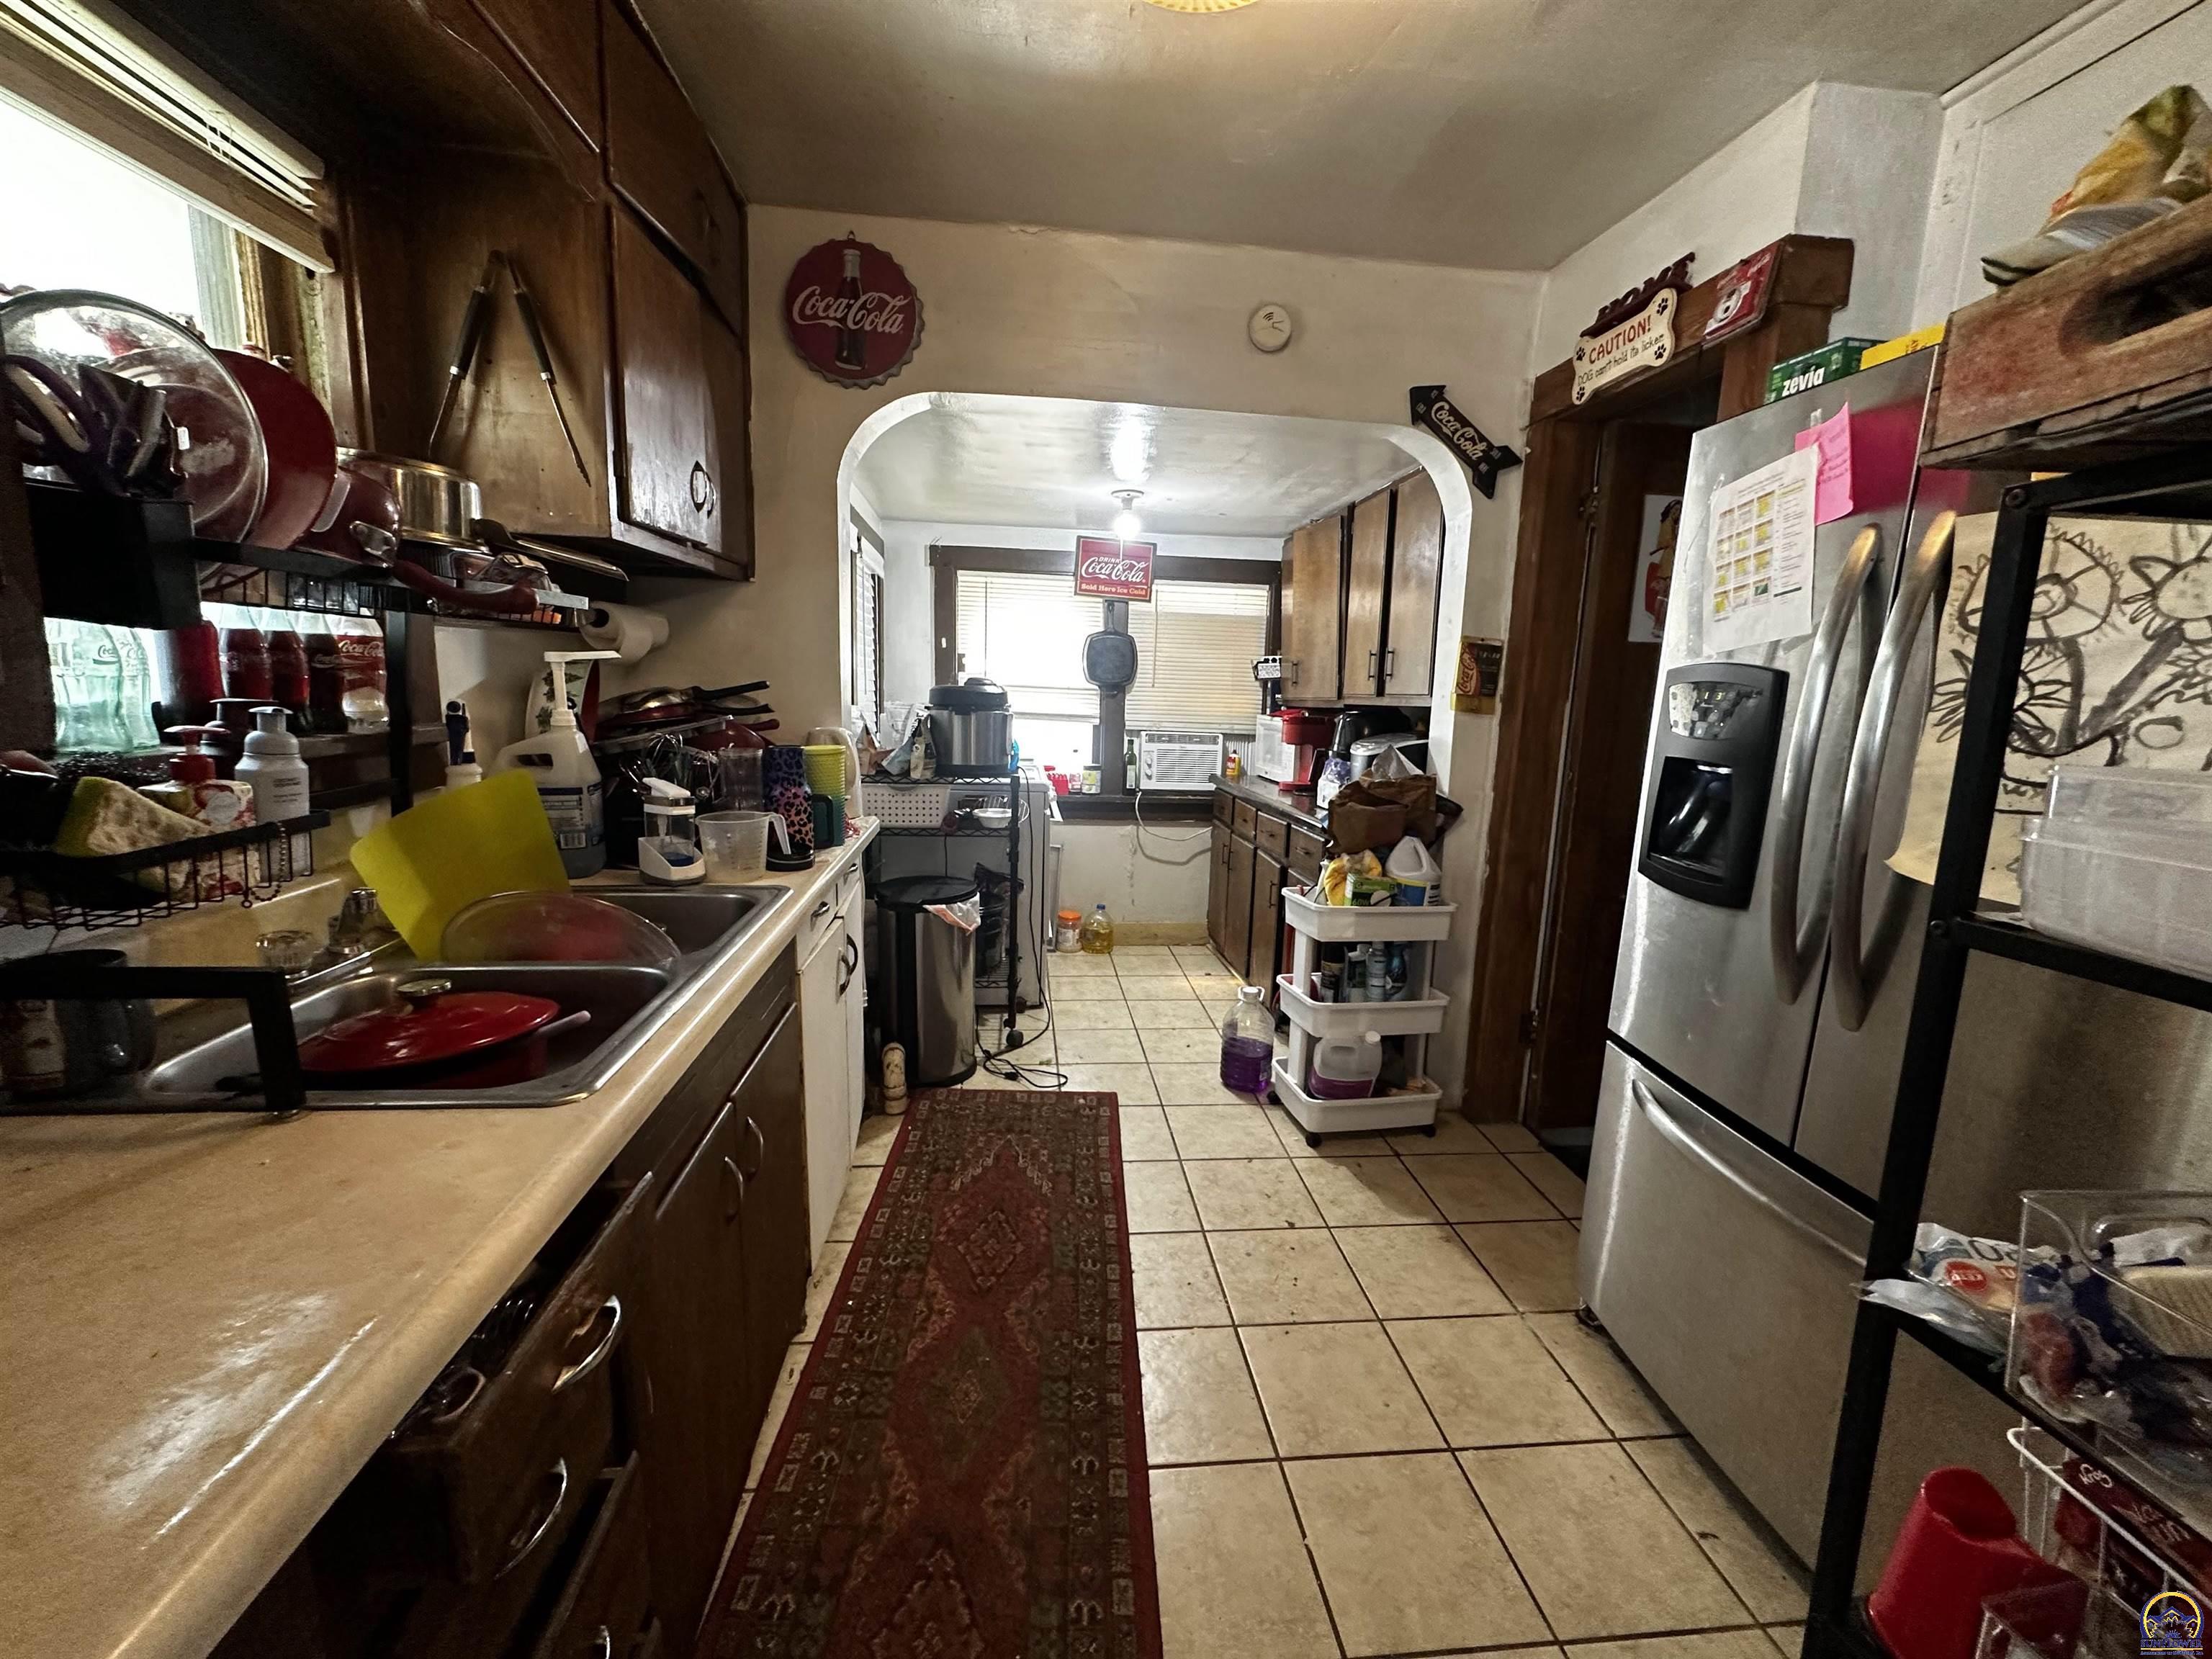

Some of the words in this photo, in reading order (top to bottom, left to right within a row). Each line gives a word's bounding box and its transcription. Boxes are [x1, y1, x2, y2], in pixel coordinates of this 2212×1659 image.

[792, 285, 911, 334] Coca-Cola
[1588, 314, 1651, 364] CAUTION!
[1577, 368, 1593, 387] DOG
[1614, 349, 1628, 366] hold
[1781, 365, 1825, 397] zevia
[1081, 557, 1149, 583] Coca-Cola
[1129, 587, 1146, 595] Cold
